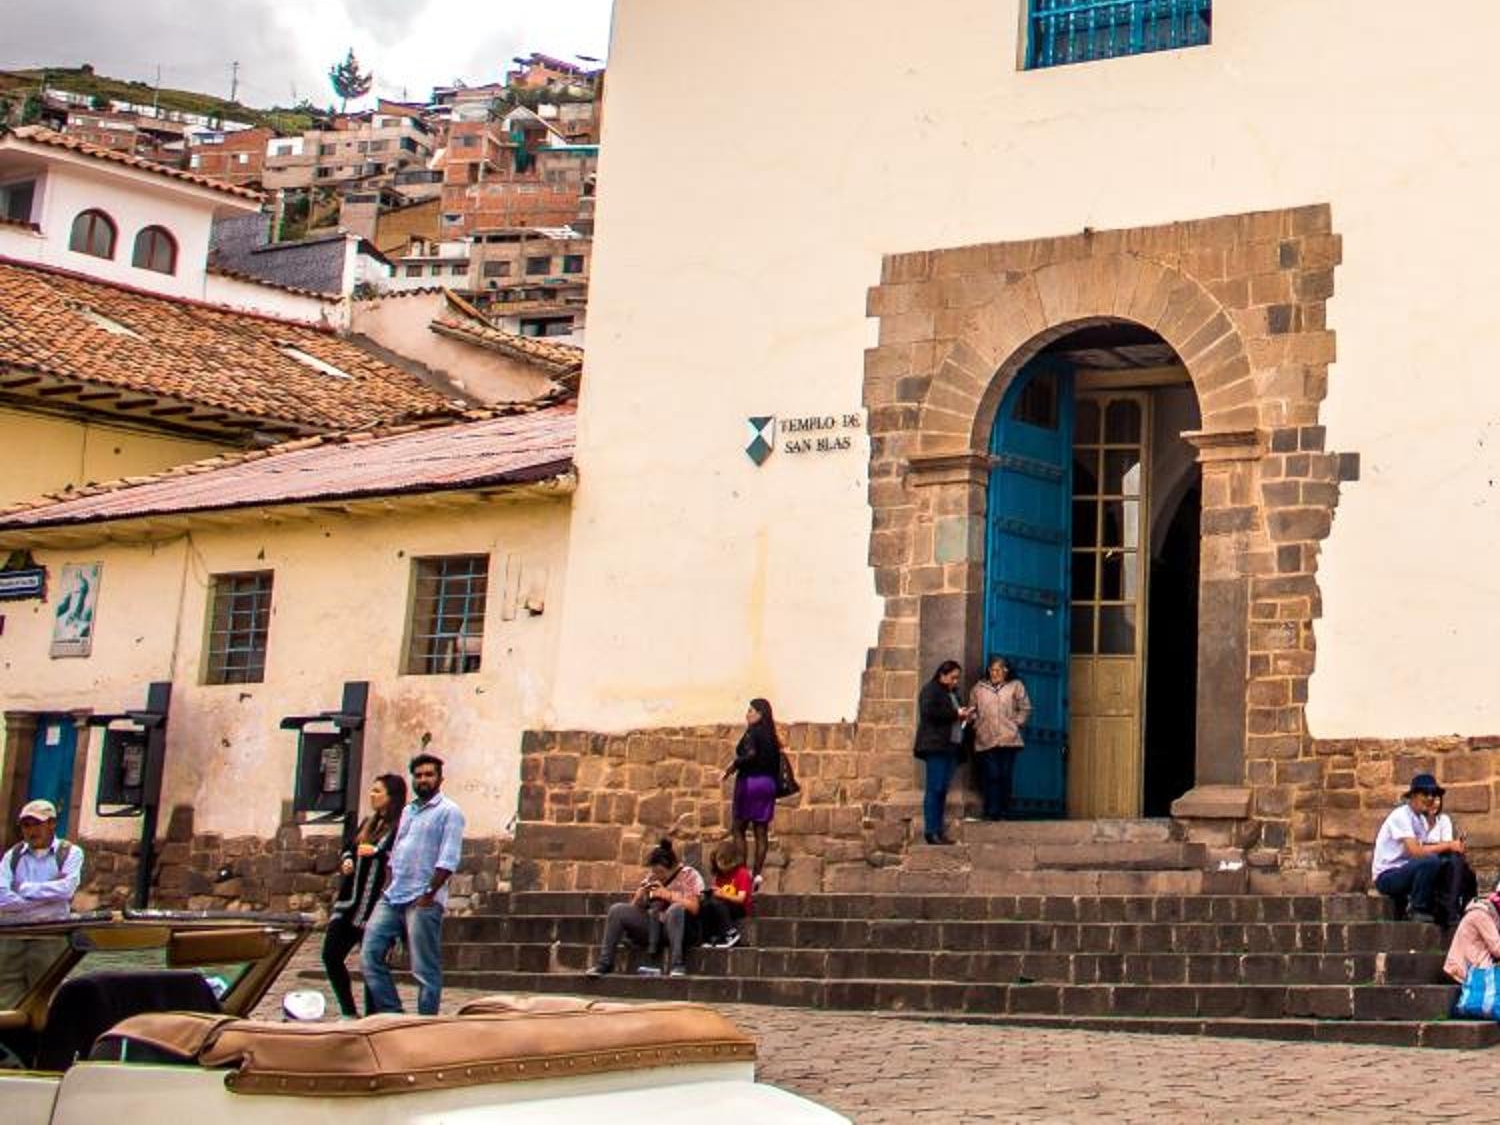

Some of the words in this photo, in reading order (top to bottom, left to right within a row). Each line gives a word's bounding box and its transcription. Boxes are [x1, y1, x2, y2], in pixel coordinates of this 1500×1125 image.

[780, 416, 835, 432] TEMPLO
[842, 414, 861, 428] DE
[784, 438, 812, 454] SAN
[816, 436, 851, 452] BLAS
